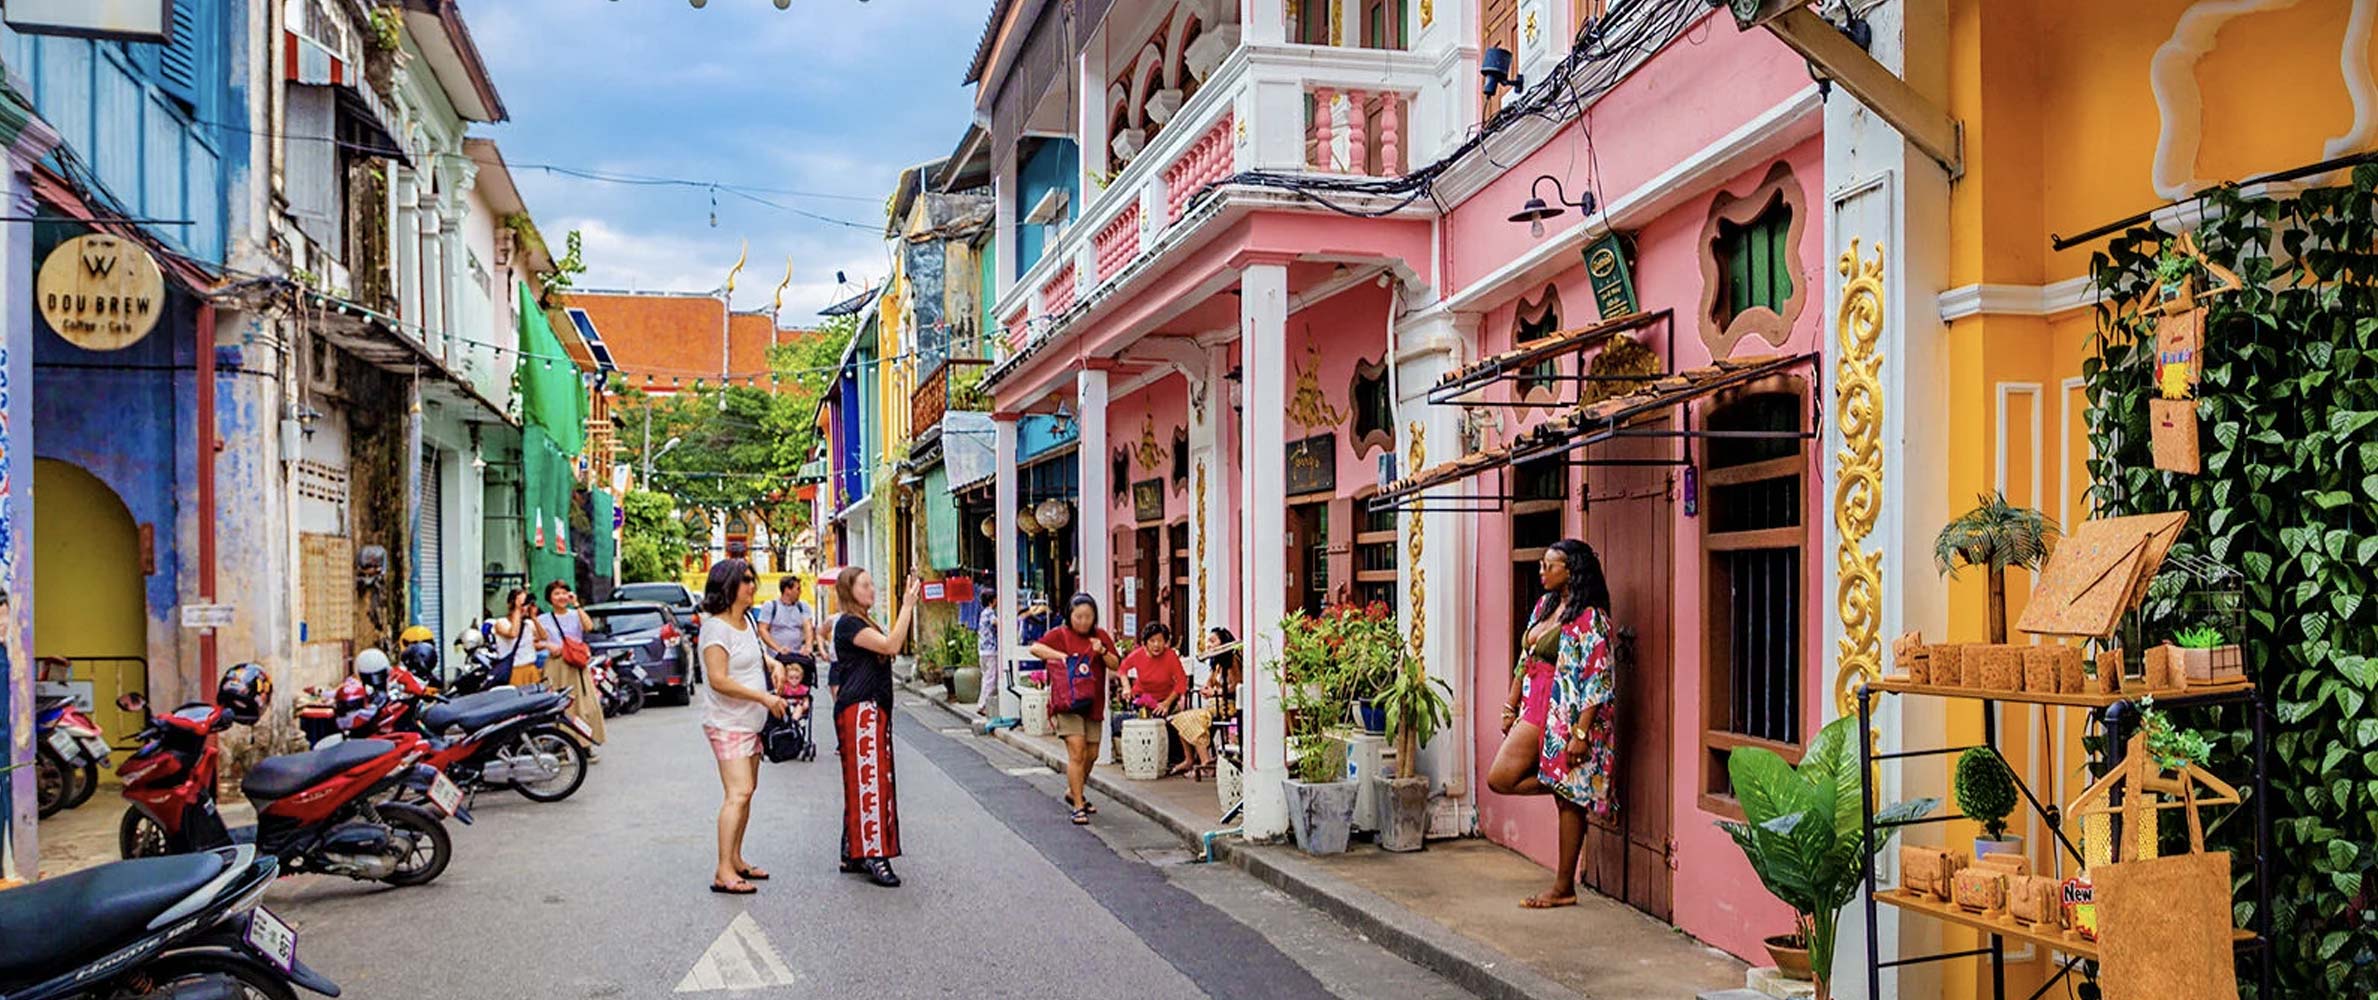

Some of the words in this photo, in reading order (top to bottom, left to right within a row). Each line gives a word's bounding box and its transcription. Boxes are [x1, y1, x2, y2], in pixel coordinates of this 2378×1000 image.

[47, 293, 86, 313] DOU
[96, 296, 150, 316] BREW
[2064, 882, 2092, 902] New
